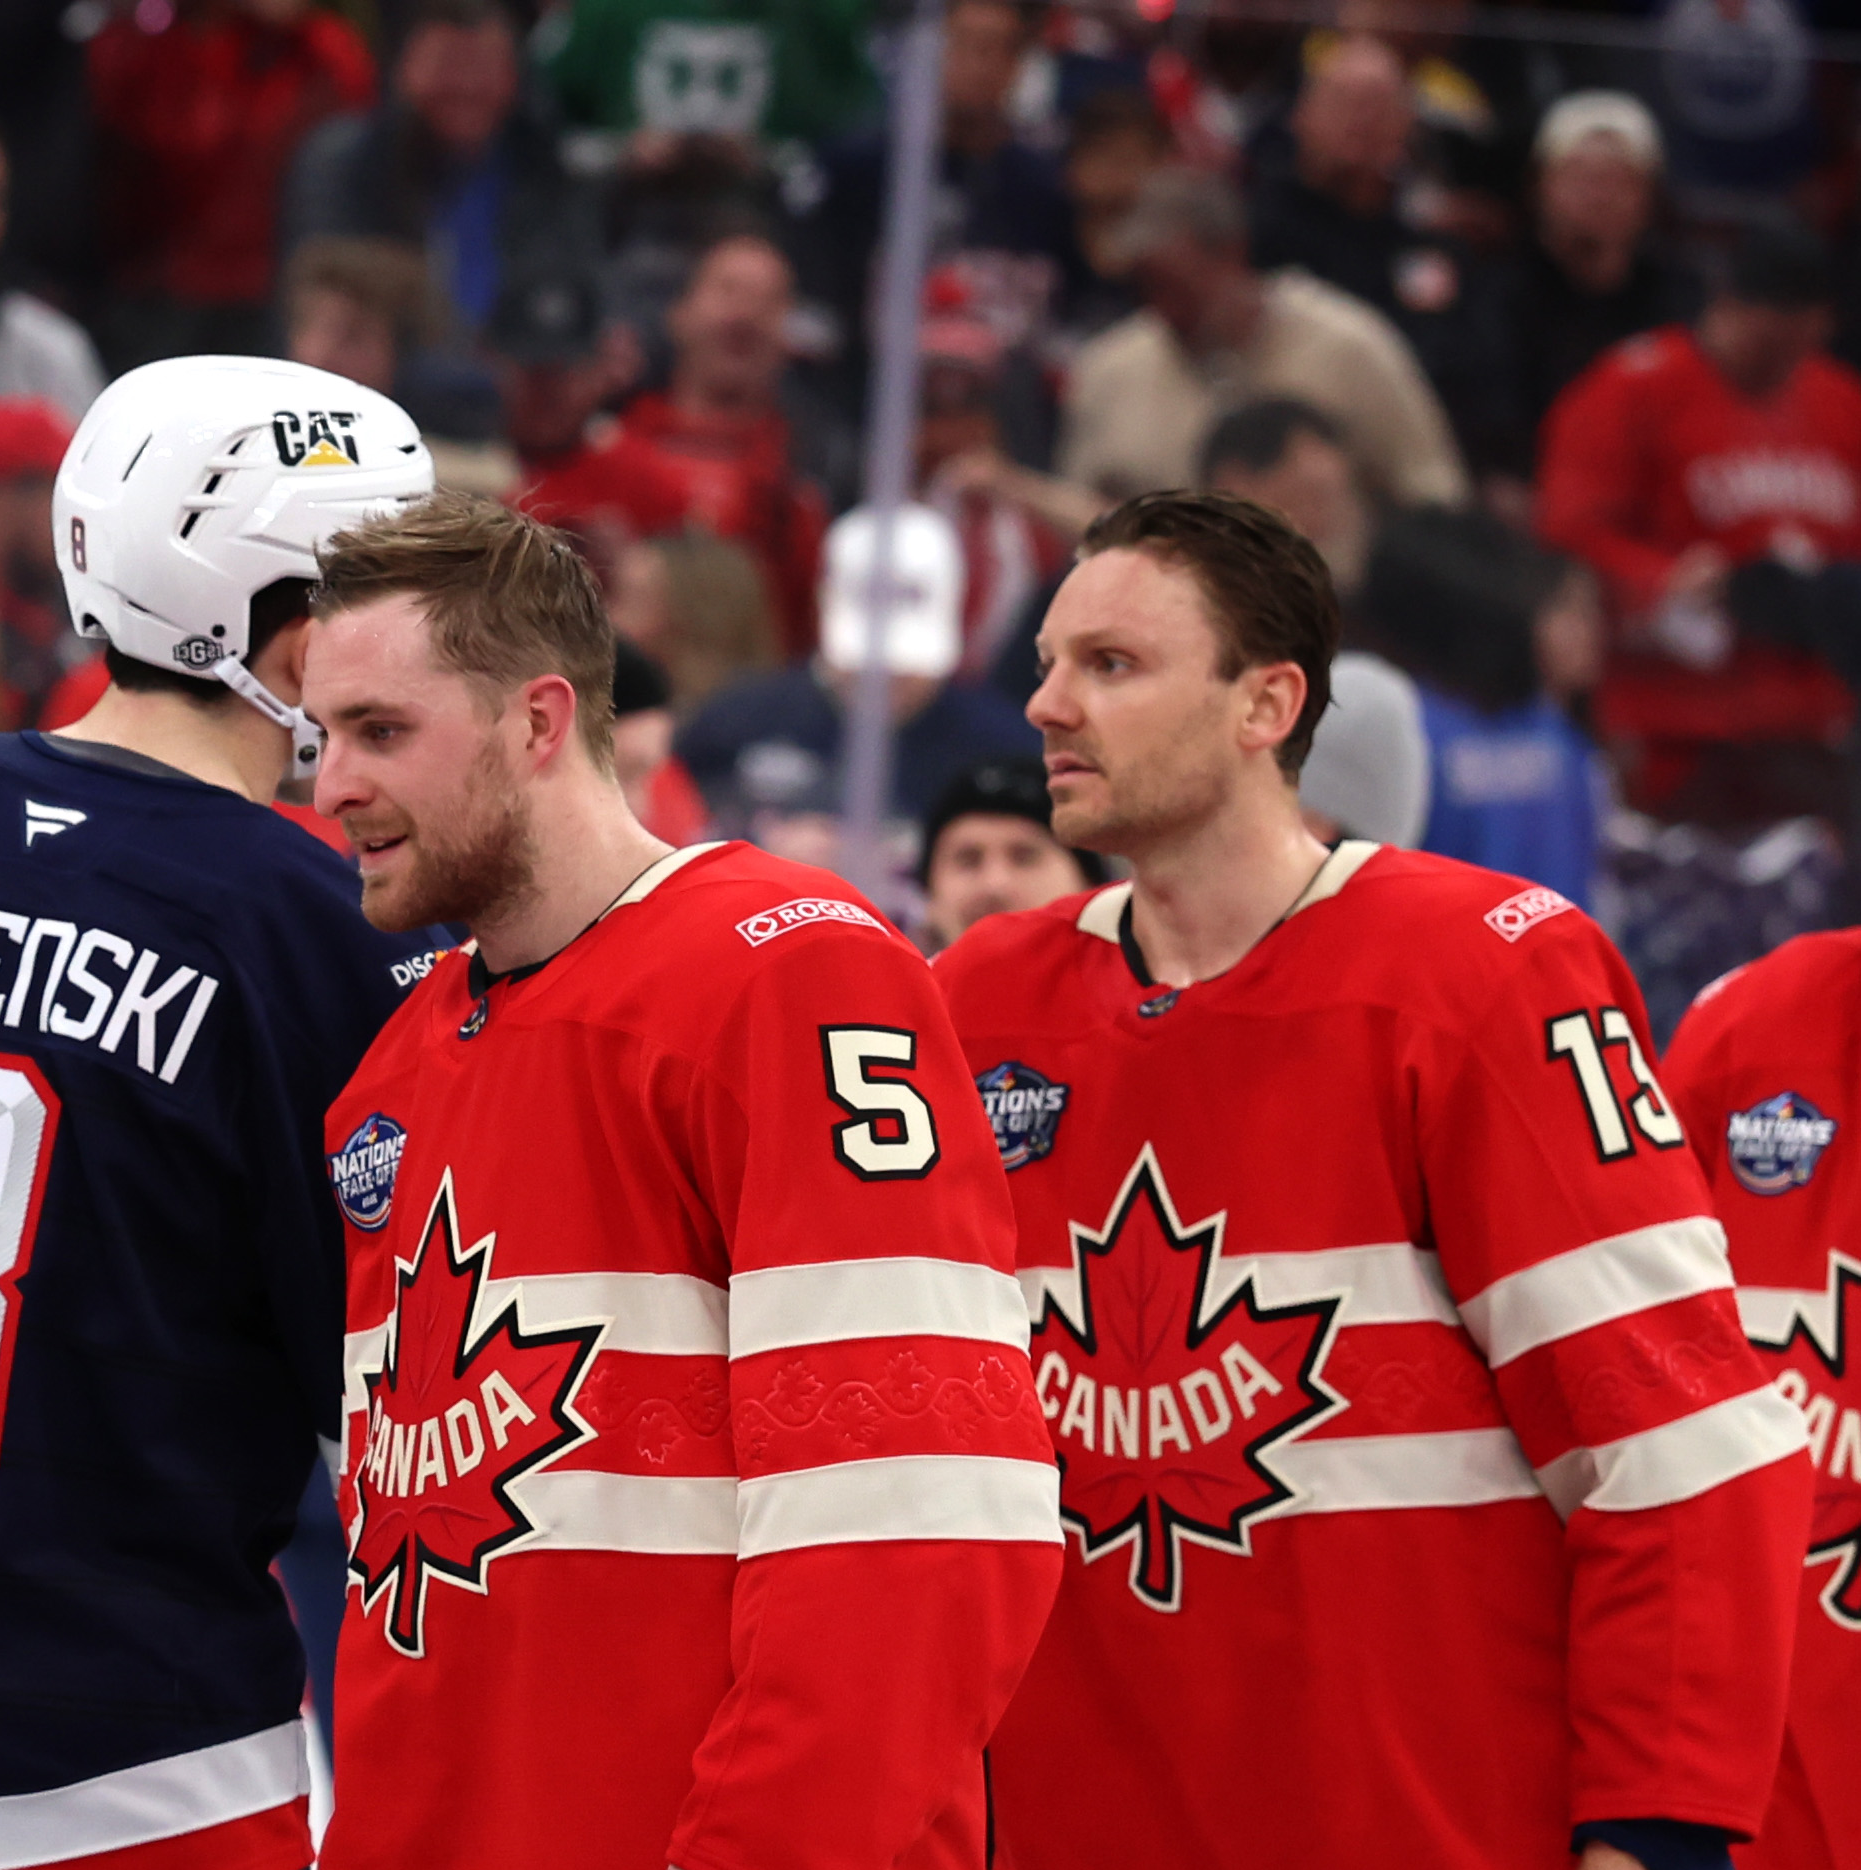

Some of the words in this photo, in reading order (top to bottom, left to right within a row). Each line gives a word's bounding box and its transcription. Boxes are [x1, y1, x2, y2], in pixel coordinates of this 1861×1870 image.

[273, 411, 360, 467] CAT
[71, 516, 87, 573] 8
[820, 1024, 941, 1184] 5
[981, 1086, 1065, 1117] TIONS
[1546, 1008, 1686, 1163] 13
[332, 1134, 408, 1182] NATIONS
[366, 1370, 537, 1498] CANADA
[1035, 1341, 1284, 1460] CANADA
